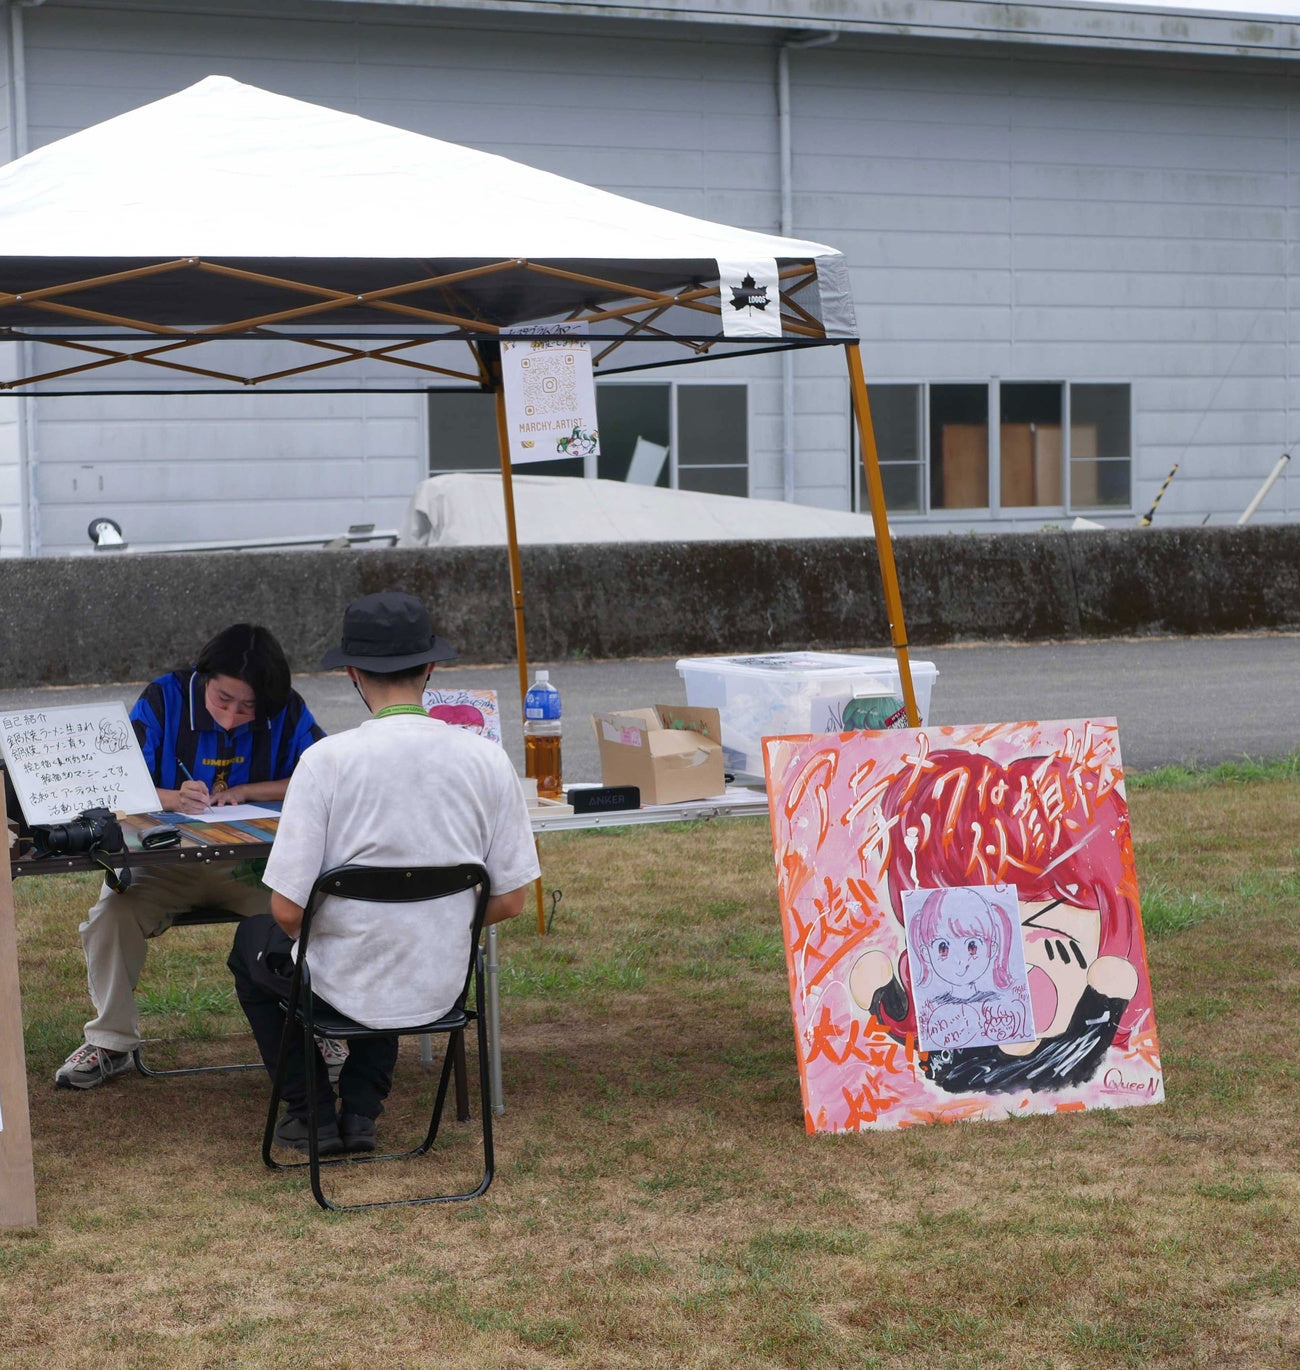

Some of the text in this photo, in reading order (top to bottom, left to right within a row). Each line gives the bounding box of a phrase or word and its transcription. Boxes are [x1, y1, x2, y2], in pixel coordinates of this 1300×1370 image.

[748, 295, 766, 304] LOGOS
[520, 418, 587, 432] MARCHY_ARTIST_
[2, 713, 47, 730] 自己紹介
[589, 794, 625, 805] ANKER
